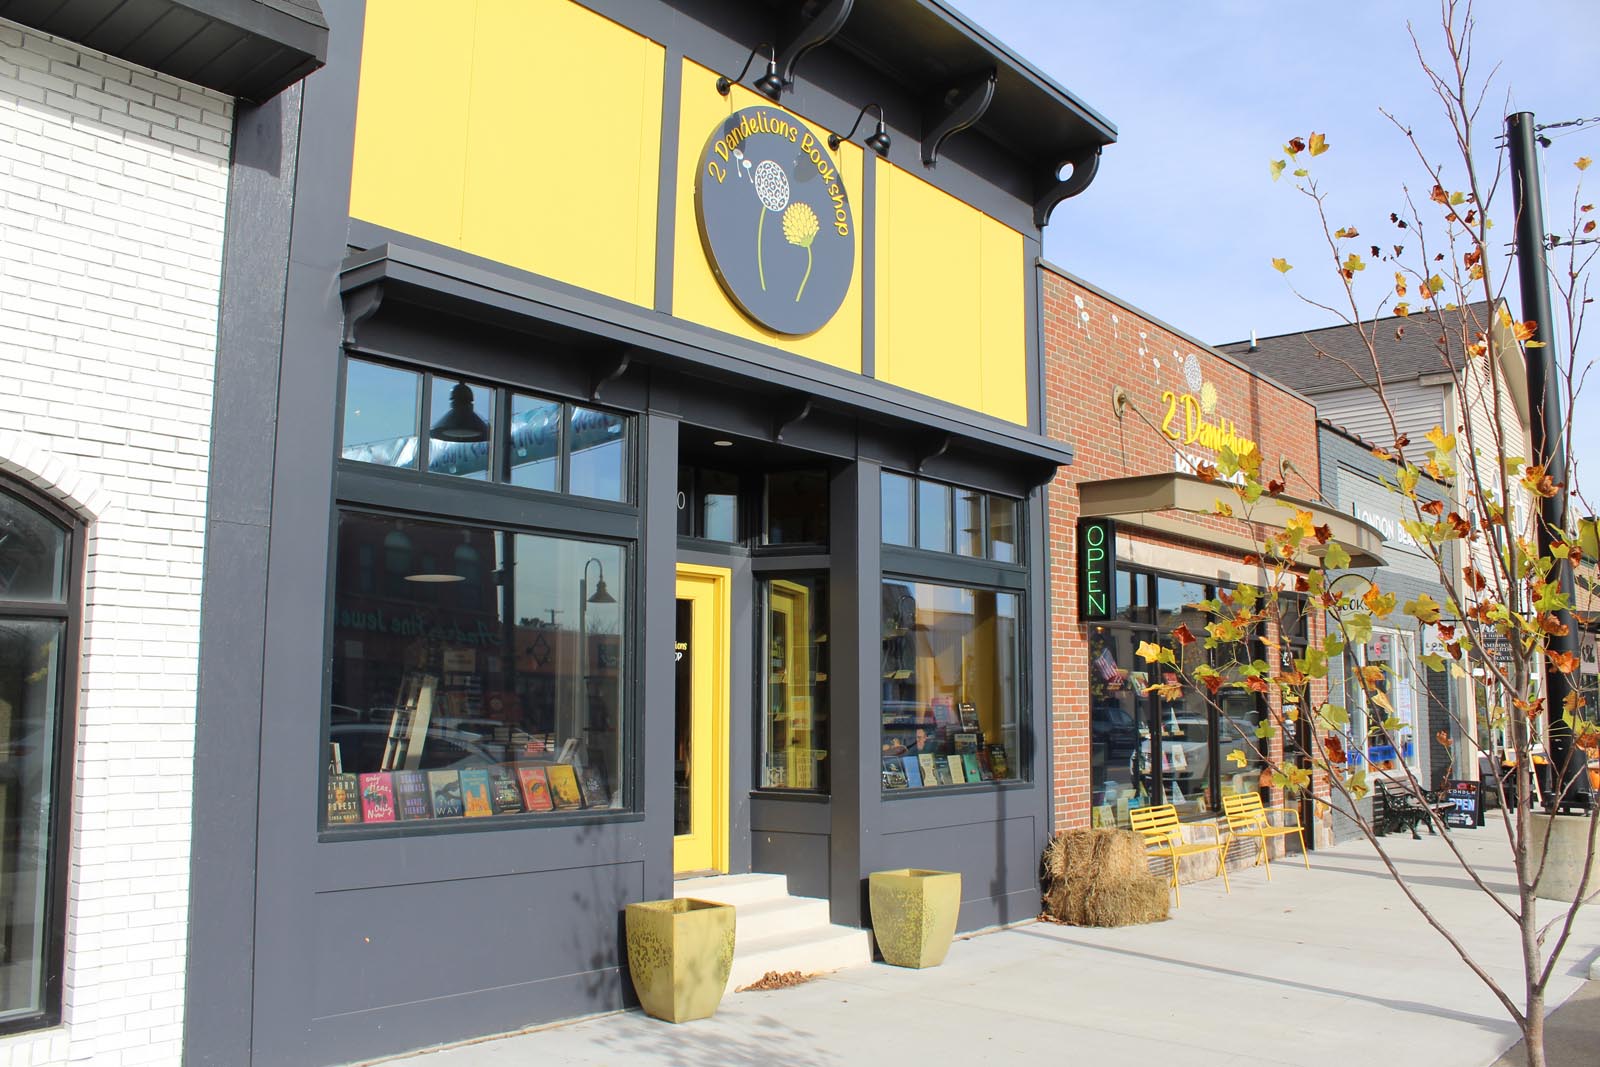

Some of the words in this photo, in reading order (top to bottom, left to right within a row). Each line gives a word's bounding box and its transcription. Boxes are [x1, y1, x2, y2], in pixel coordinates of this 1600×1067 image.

[714, 111, 798, 162] Dandelions
[708, 161, 726, 183] 2
[801, 132, 849, 236] Bookshop
[1162, 391, 1180, 440] 2
[1087, 526, 1106, 615] OPEN
[436, 807, 459, 816] WAY
